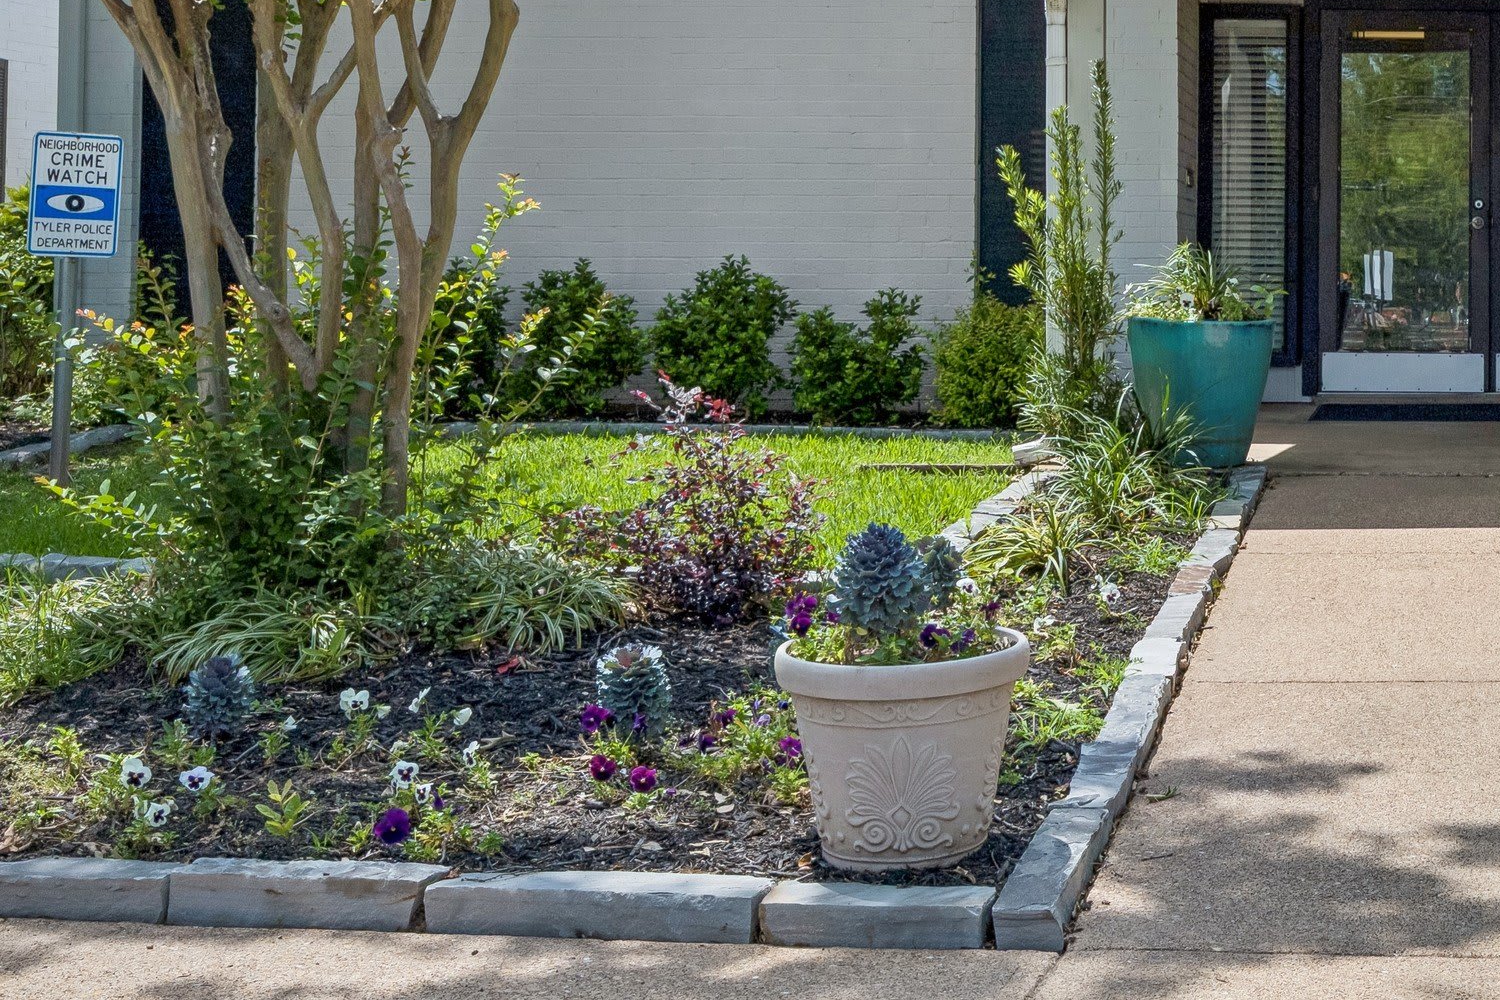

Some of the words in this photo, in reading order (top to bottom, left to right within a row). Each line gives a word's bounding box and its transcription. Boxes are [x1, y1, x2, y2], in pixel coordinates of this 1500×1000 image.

[39, 139, 120, 154] NEIGHBORHOOD
[51, 152, 106, 169] CRIME
[47, 168, 108, 185] WATCH
[34, 221, 71, 233] TYLER
[74, 224, 113, 235] POLICE
[37, 237, 110, 250] DEPARTMENT
